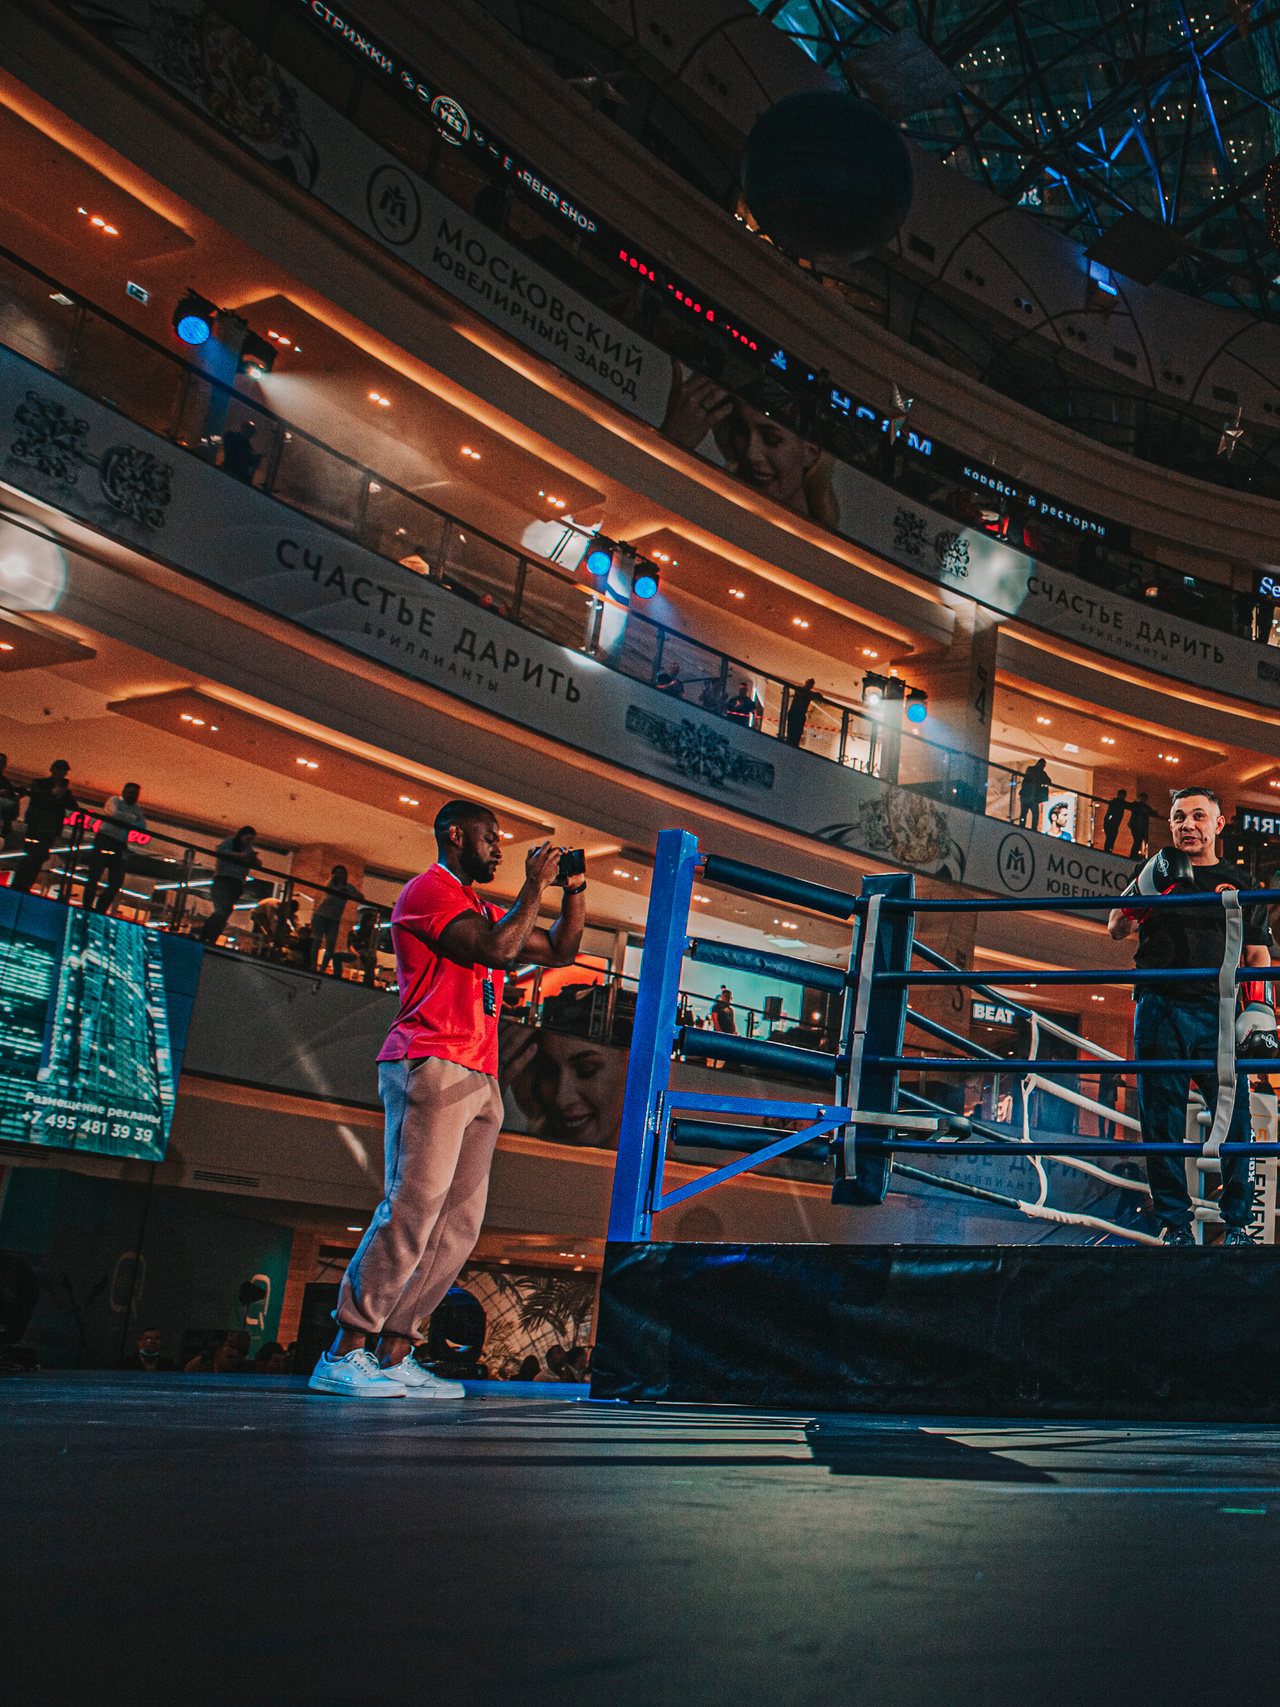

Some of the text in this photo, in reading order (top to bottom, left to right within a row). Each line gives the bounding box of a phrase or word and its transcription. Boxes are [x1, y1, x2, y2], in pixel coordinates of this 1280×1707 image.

[312, 0, 394, 74] СТРИЖКИ
[439, 106, 463, 133] YES
[503, 155, 597, 233] BRBER SHOP
[433, 246, 638, 401] ЮВЕЛИРНЫЙ ЗАВОД
[437, 217, 644, 377] МОСКОВСКИЙ
[963, 466, 1106, 537] корейсй ресторан
[276, 539, 581, 703] СЧАСТЬЕ ДАРИТЬ
[1027, 576, 1225, 664] СЧАСТЬЕ ДАРИТЬ
[1081, 623, 1169, 662] БРИЛЛИАНТЫ
[363, 622, 498, 693] БРИЛЛИАНТЫ
[1047, 854, 1130, 892] МОСКО
[973, 1002, 1015, 1025] BEAT
[22, 1110, 153, 1142] +7 495 481 39 39
[25, 1091, 161, 1124] Размещение рекламы
[945, 1171, 1035, 1190] БРИЛЛИАНТ
[1248, 1128, 1267, 1244] 5LEMEN
